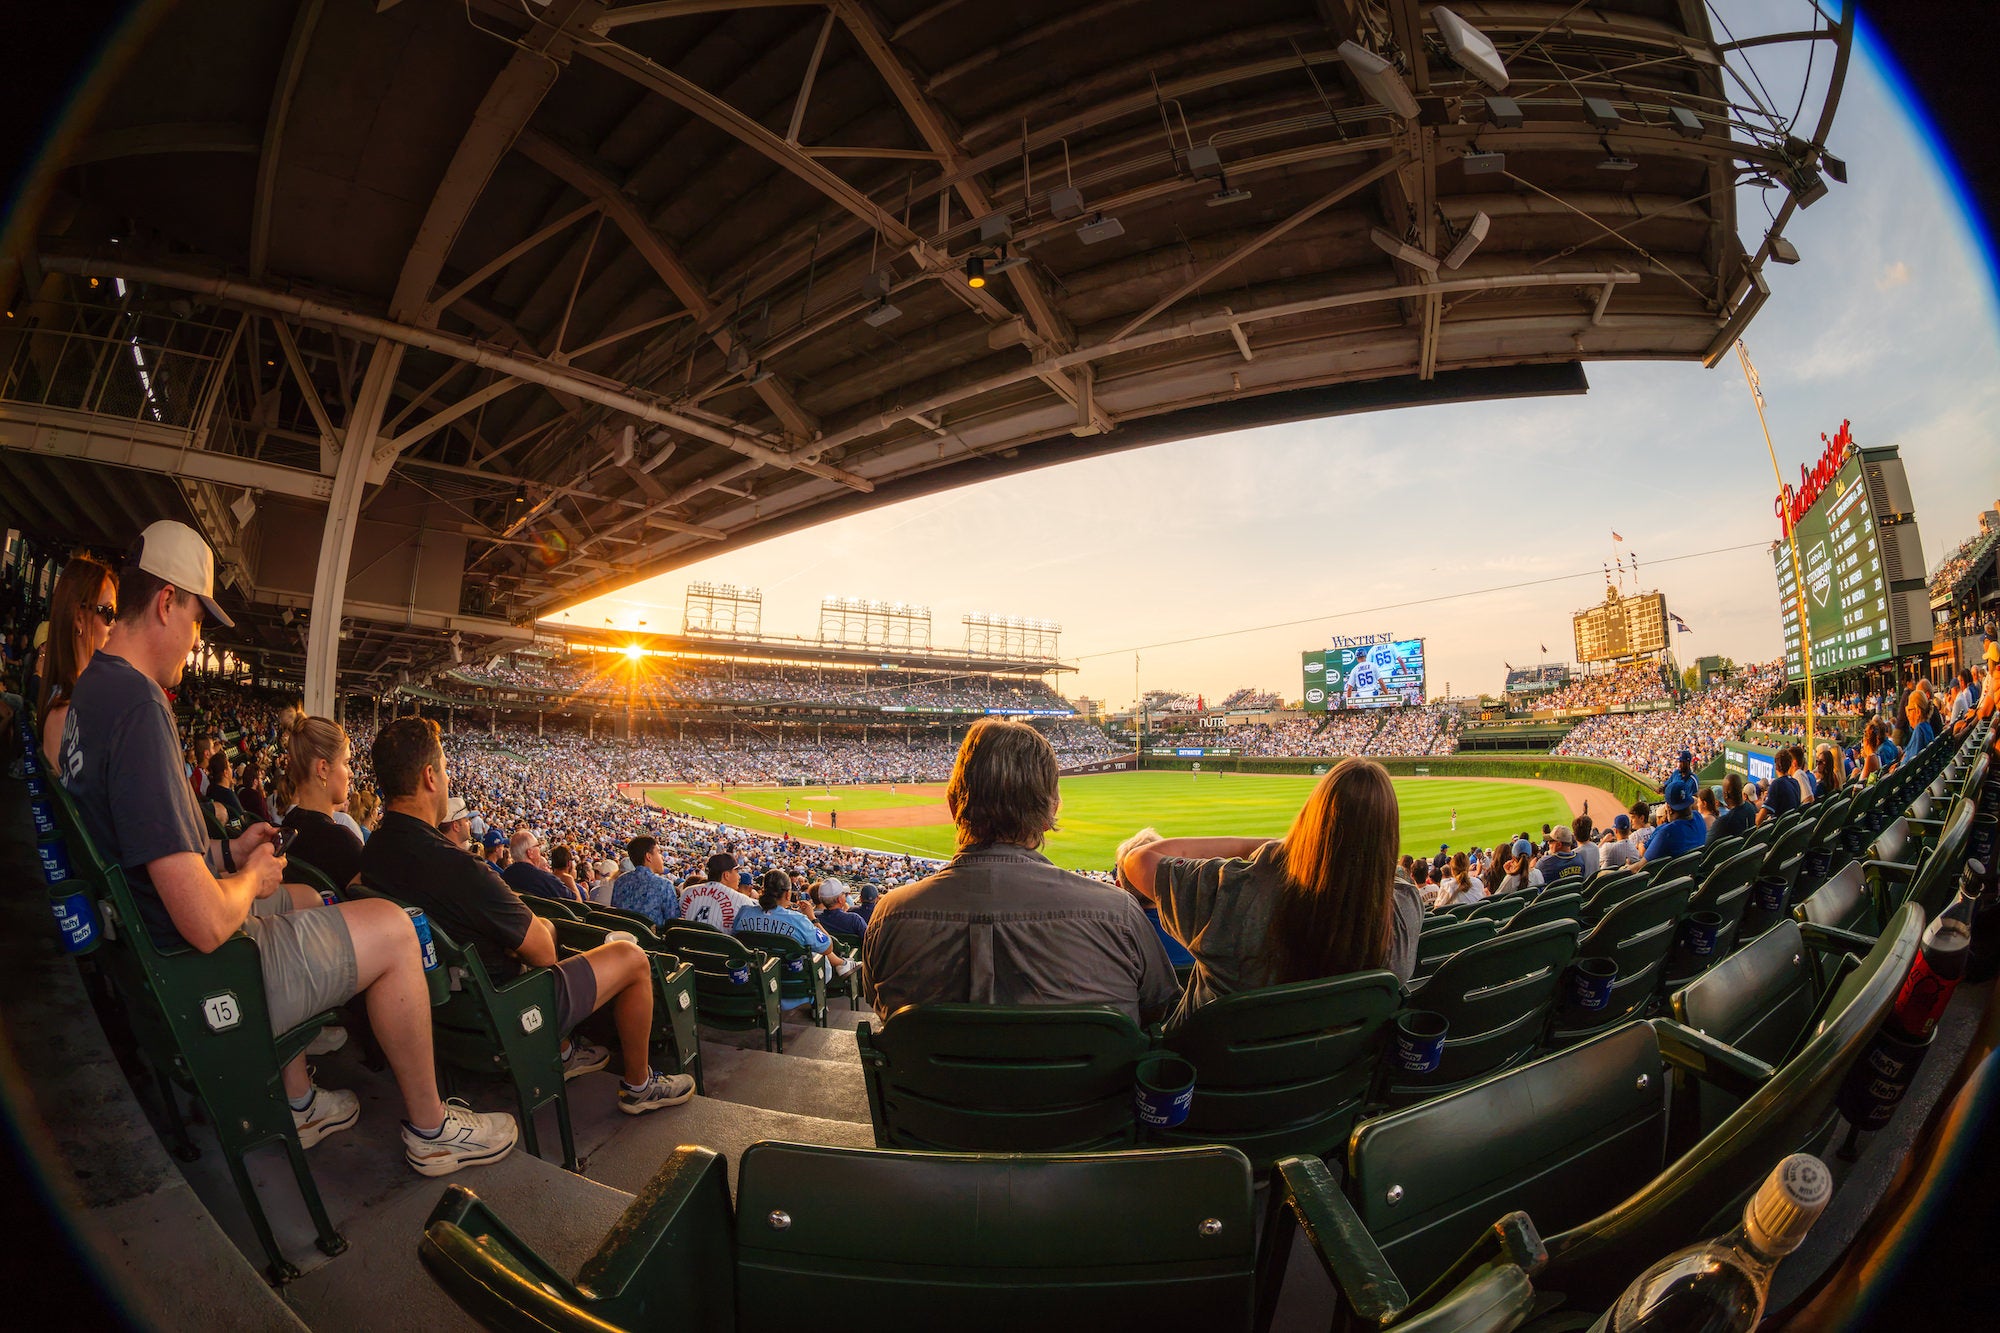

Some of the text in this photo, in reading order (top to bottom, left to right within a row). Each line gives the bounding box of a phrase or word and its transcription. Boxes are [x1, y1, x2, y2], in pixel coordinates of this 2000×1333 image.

[1375, 650, 1392, 667] 65
[1357, 670, 1374, 687] 65
[1559, 865, 1582, 878] UECKER
[62, 917, 78, 929] Hefty
[740, 917, 795, 936] HOERNER
[74, 927, 90, 943] Hefty
[211, 1001, 231, 1022] 15
[526, 1013, 538, 1028] 14
